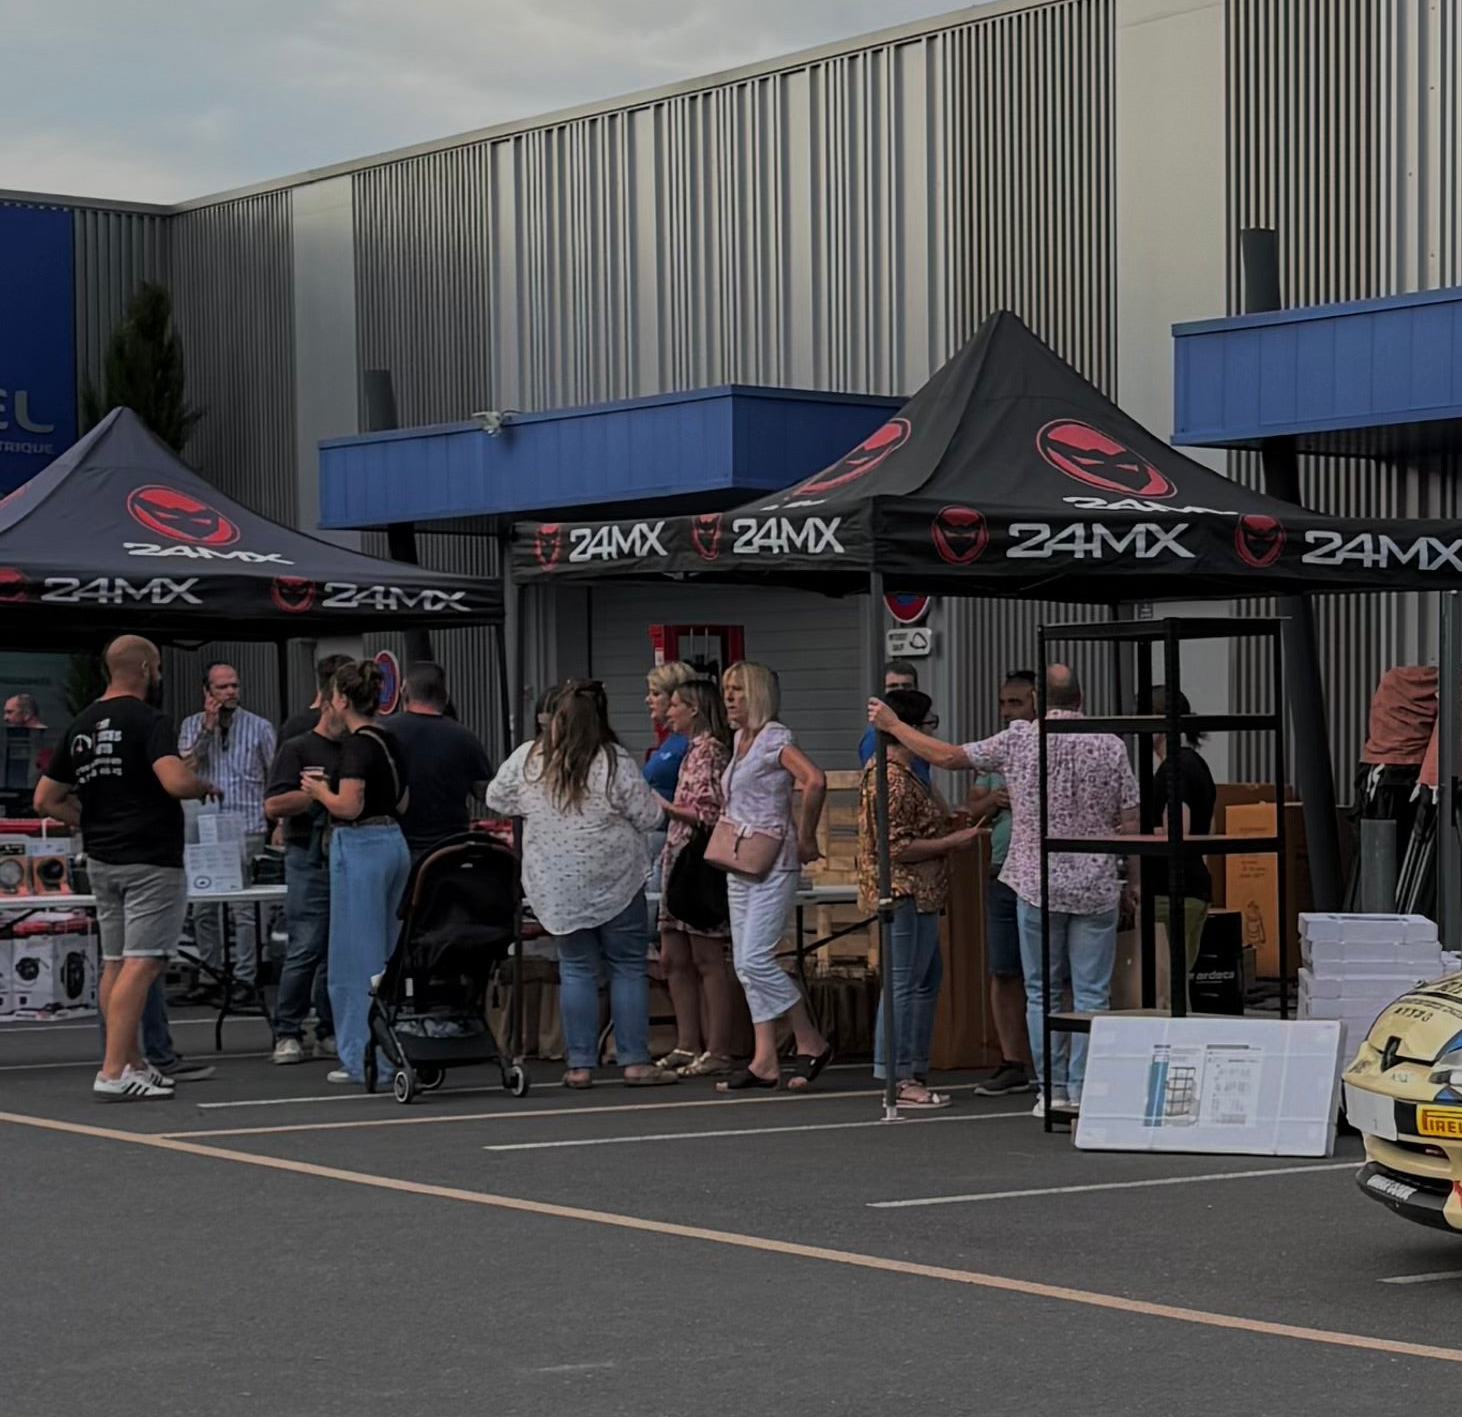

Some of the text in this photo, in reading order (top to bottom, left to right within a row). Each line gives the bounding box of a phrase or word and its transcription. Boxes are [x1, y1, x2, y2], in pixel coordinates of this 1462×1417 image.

[0, 389, 55, 433] L
[1062, 496, 1238, 516] 24
[569, 521, 668, 563] 24MX
[732, 517, 845, 554] 24MX
[1005, 522, 1196, 559] 24MX
[123, 542, 295, 566] 24MX
[41, 577, 204, 605] 24MX
[322, 582, 472, 612] 24MX
